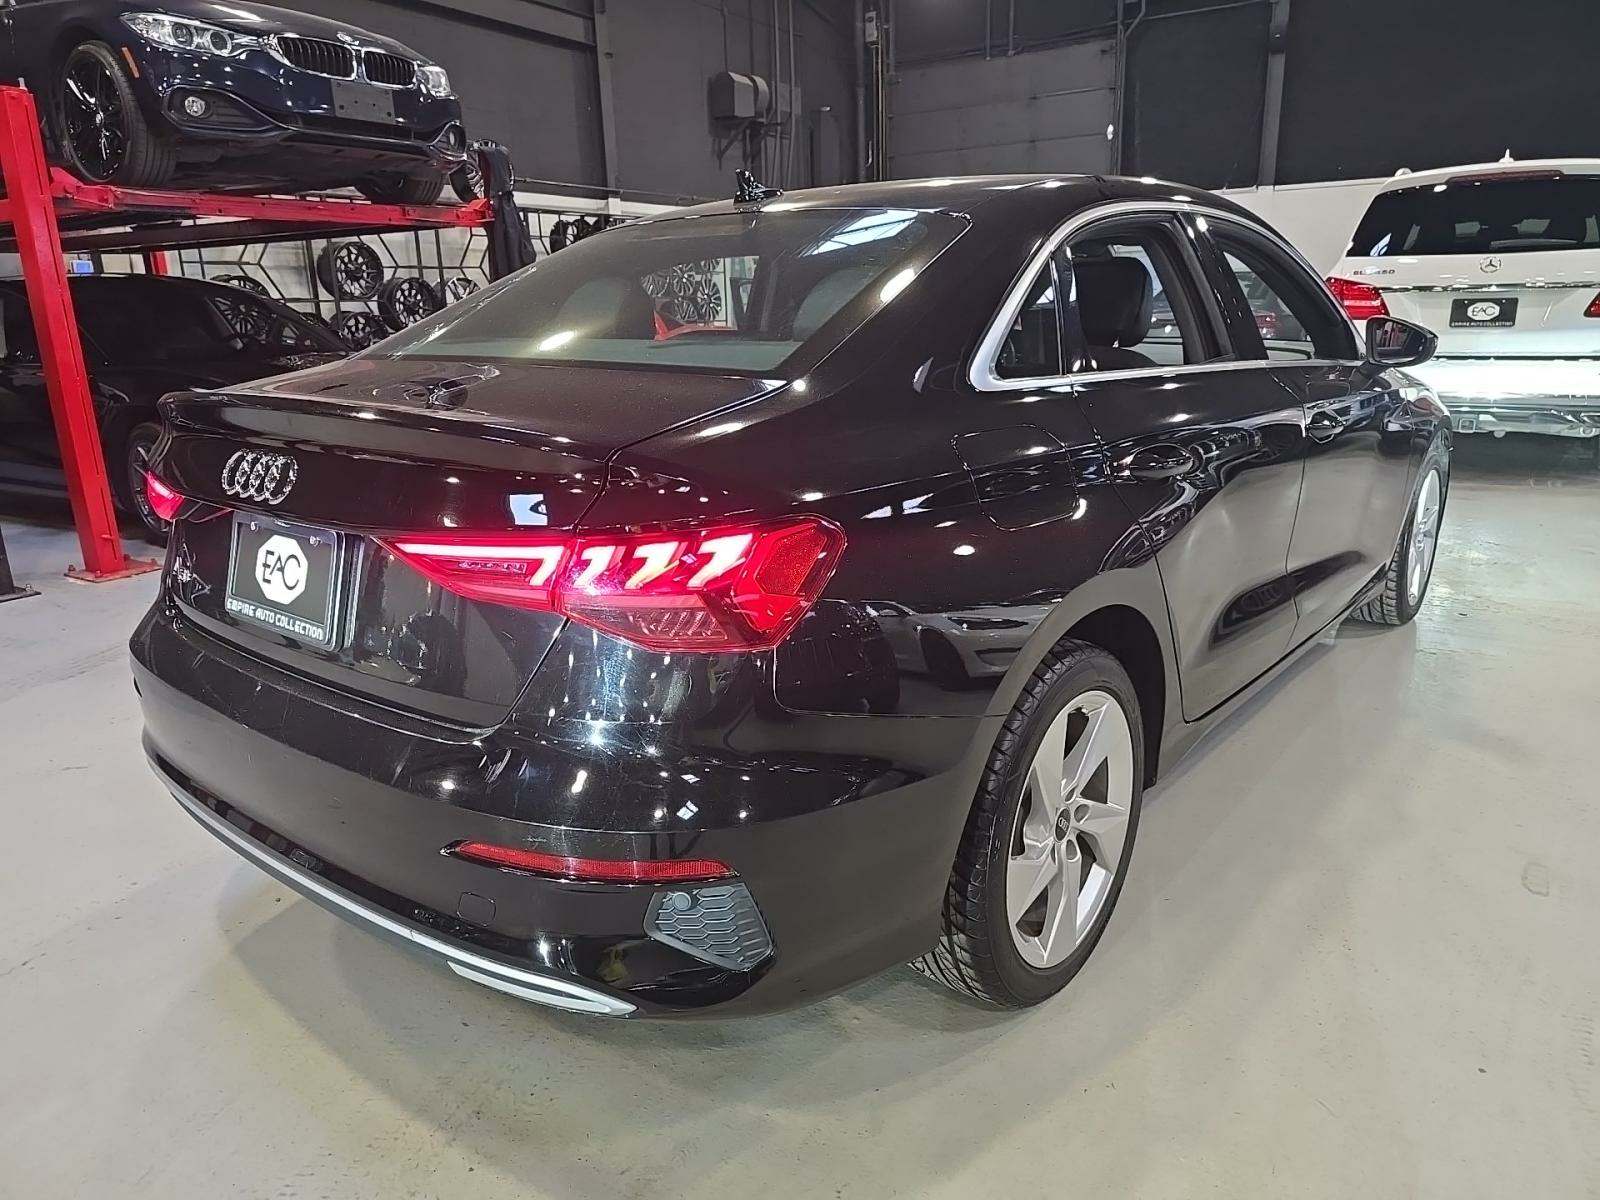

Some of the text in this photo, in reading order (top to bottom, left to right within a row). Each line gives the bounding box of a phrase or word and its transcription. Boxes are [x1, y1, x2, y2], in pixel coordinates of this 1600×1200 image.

[1471, 306, 1496, 316] EAC
[262, 549, 301, 590] EAC
[227, 598, 324, 641] EMPIRE AUTO COLLECTION
